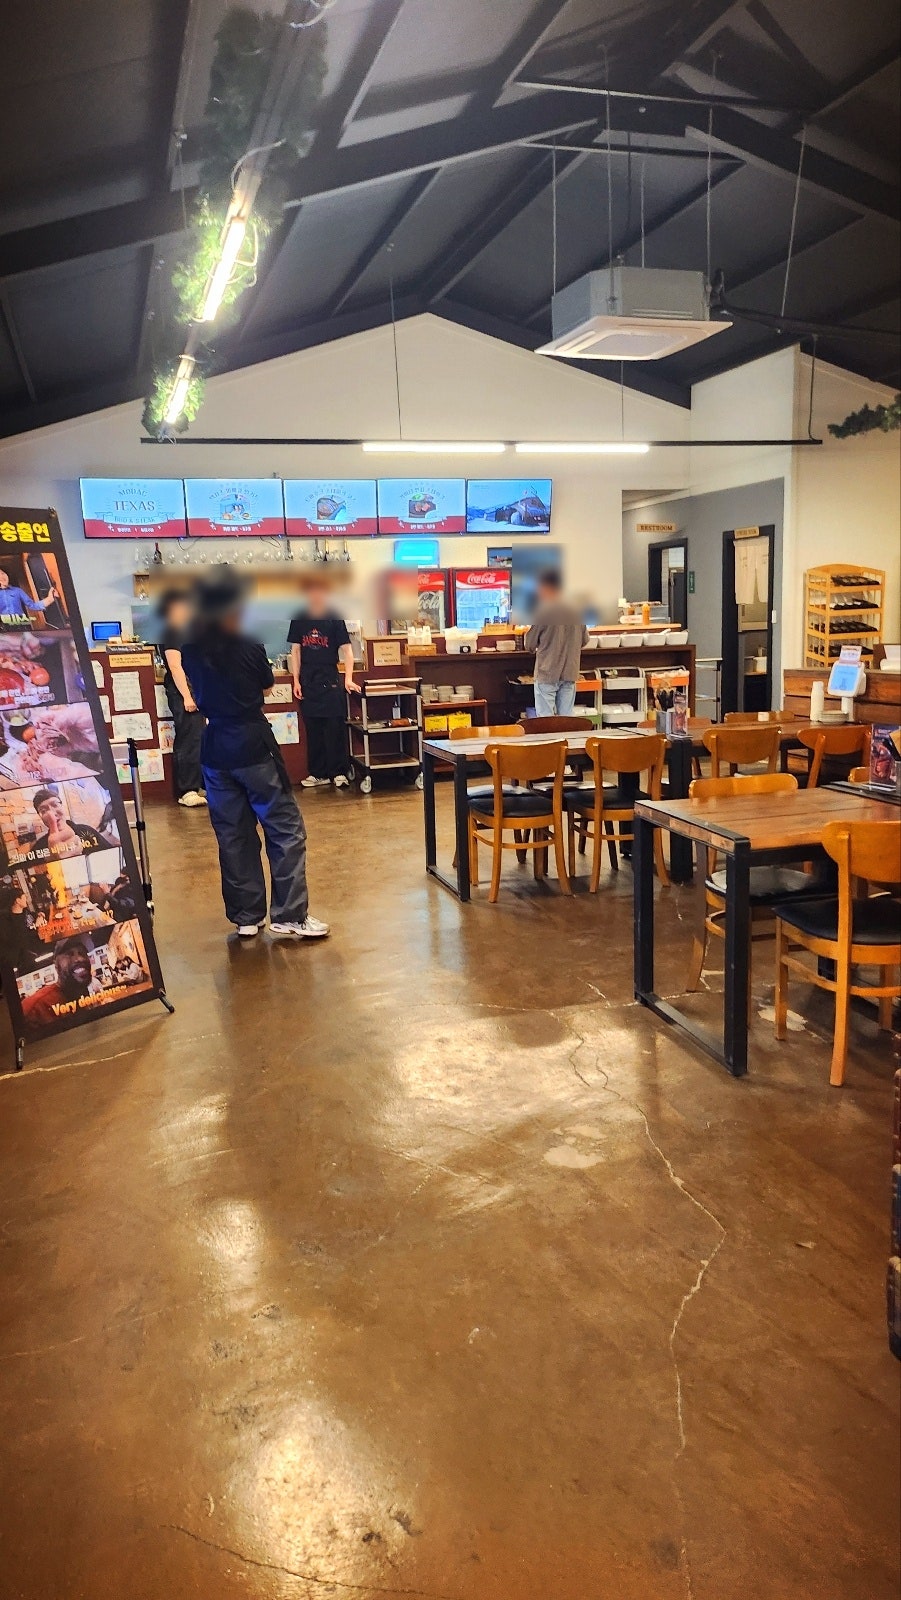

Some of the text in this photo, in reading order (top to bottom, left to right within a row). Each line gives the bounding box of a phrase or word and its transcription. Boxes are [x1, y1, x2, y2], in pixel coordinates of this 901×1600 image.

[113, 500, 155, 511] TEXAS
[640, 524, 673, 532] RESTROOM
[27, 850, 36, 861] 이
[51, 1000, 77, 1016] Very
